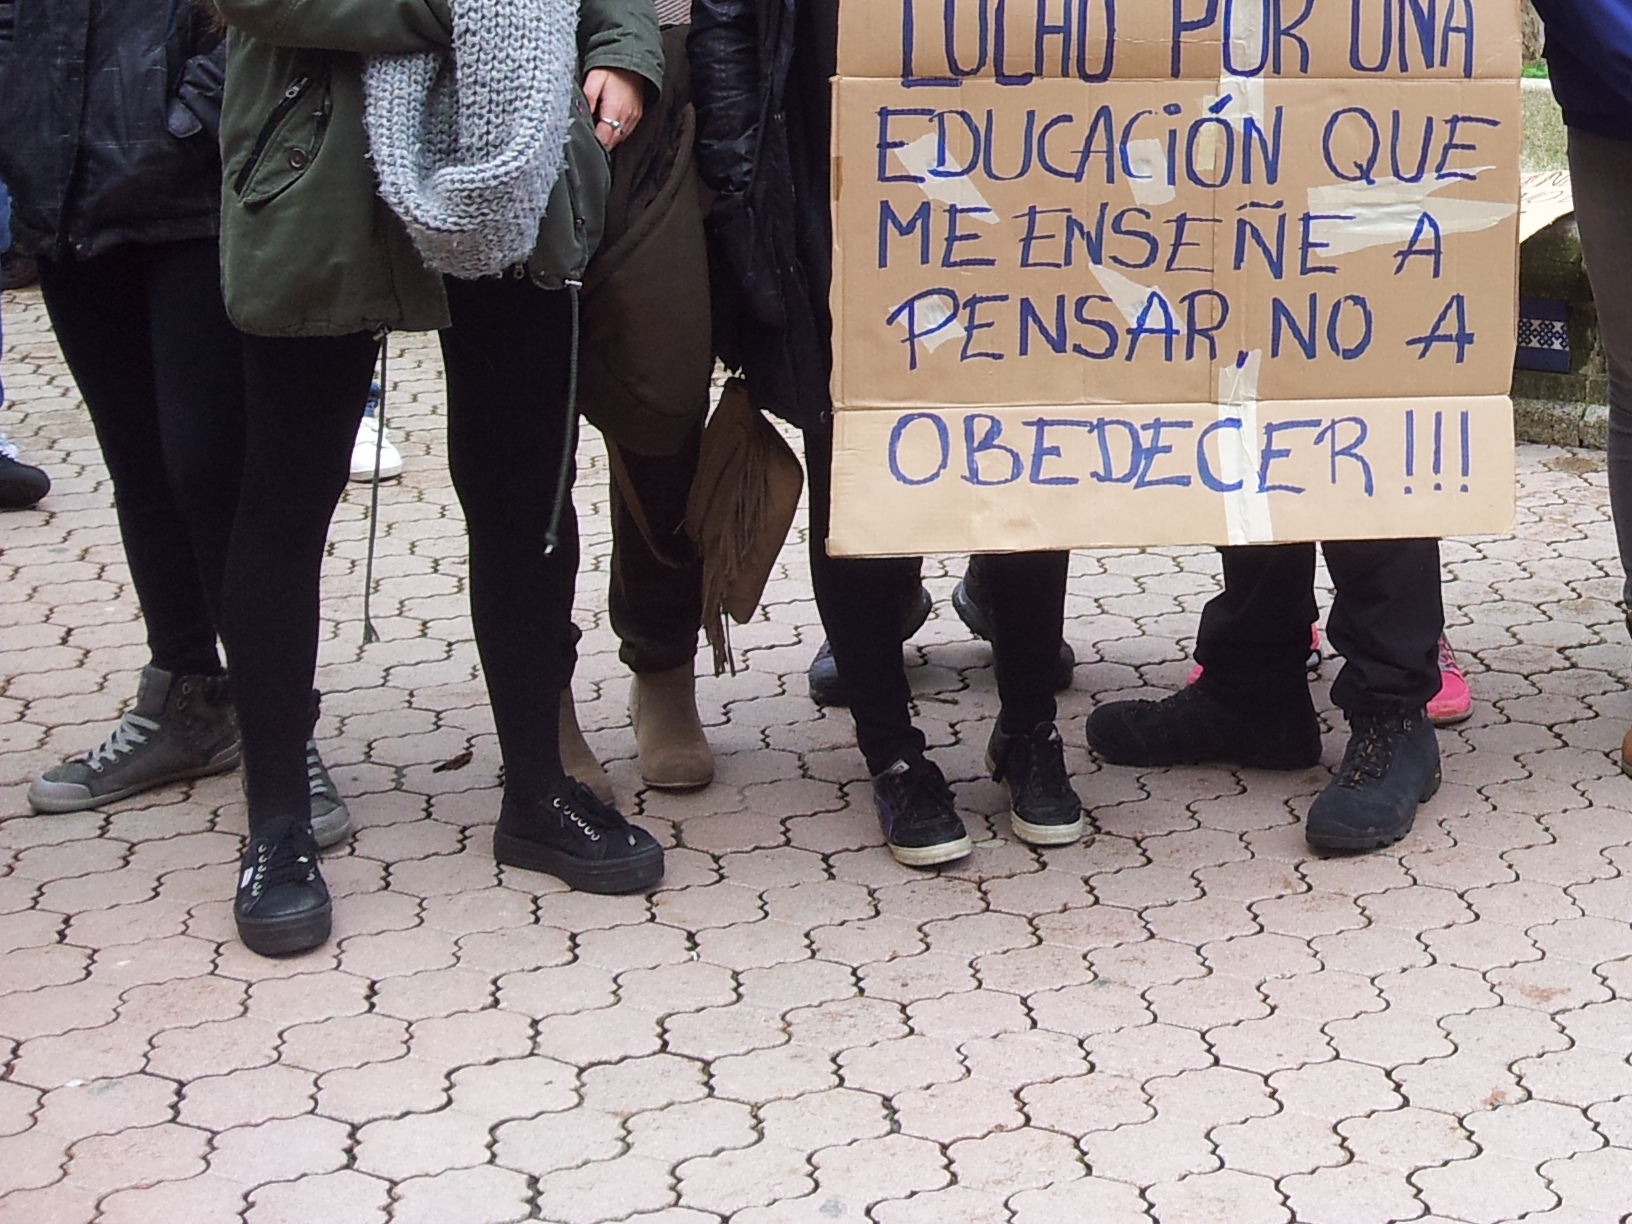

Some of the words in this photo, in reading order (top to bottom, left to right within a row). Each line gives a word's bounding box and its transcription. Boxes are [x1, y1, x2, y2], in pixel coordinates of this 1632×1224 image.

[1321, 106, 1500, 185] QUE
[877, 200, 996, 269] ME
[1012, 200, 1356, 280] ENSEÑE
[1394, 213, 1442, 278] A
[1269, 294, 1373, 361] NO
[1405, 294, 1476, 364] A
